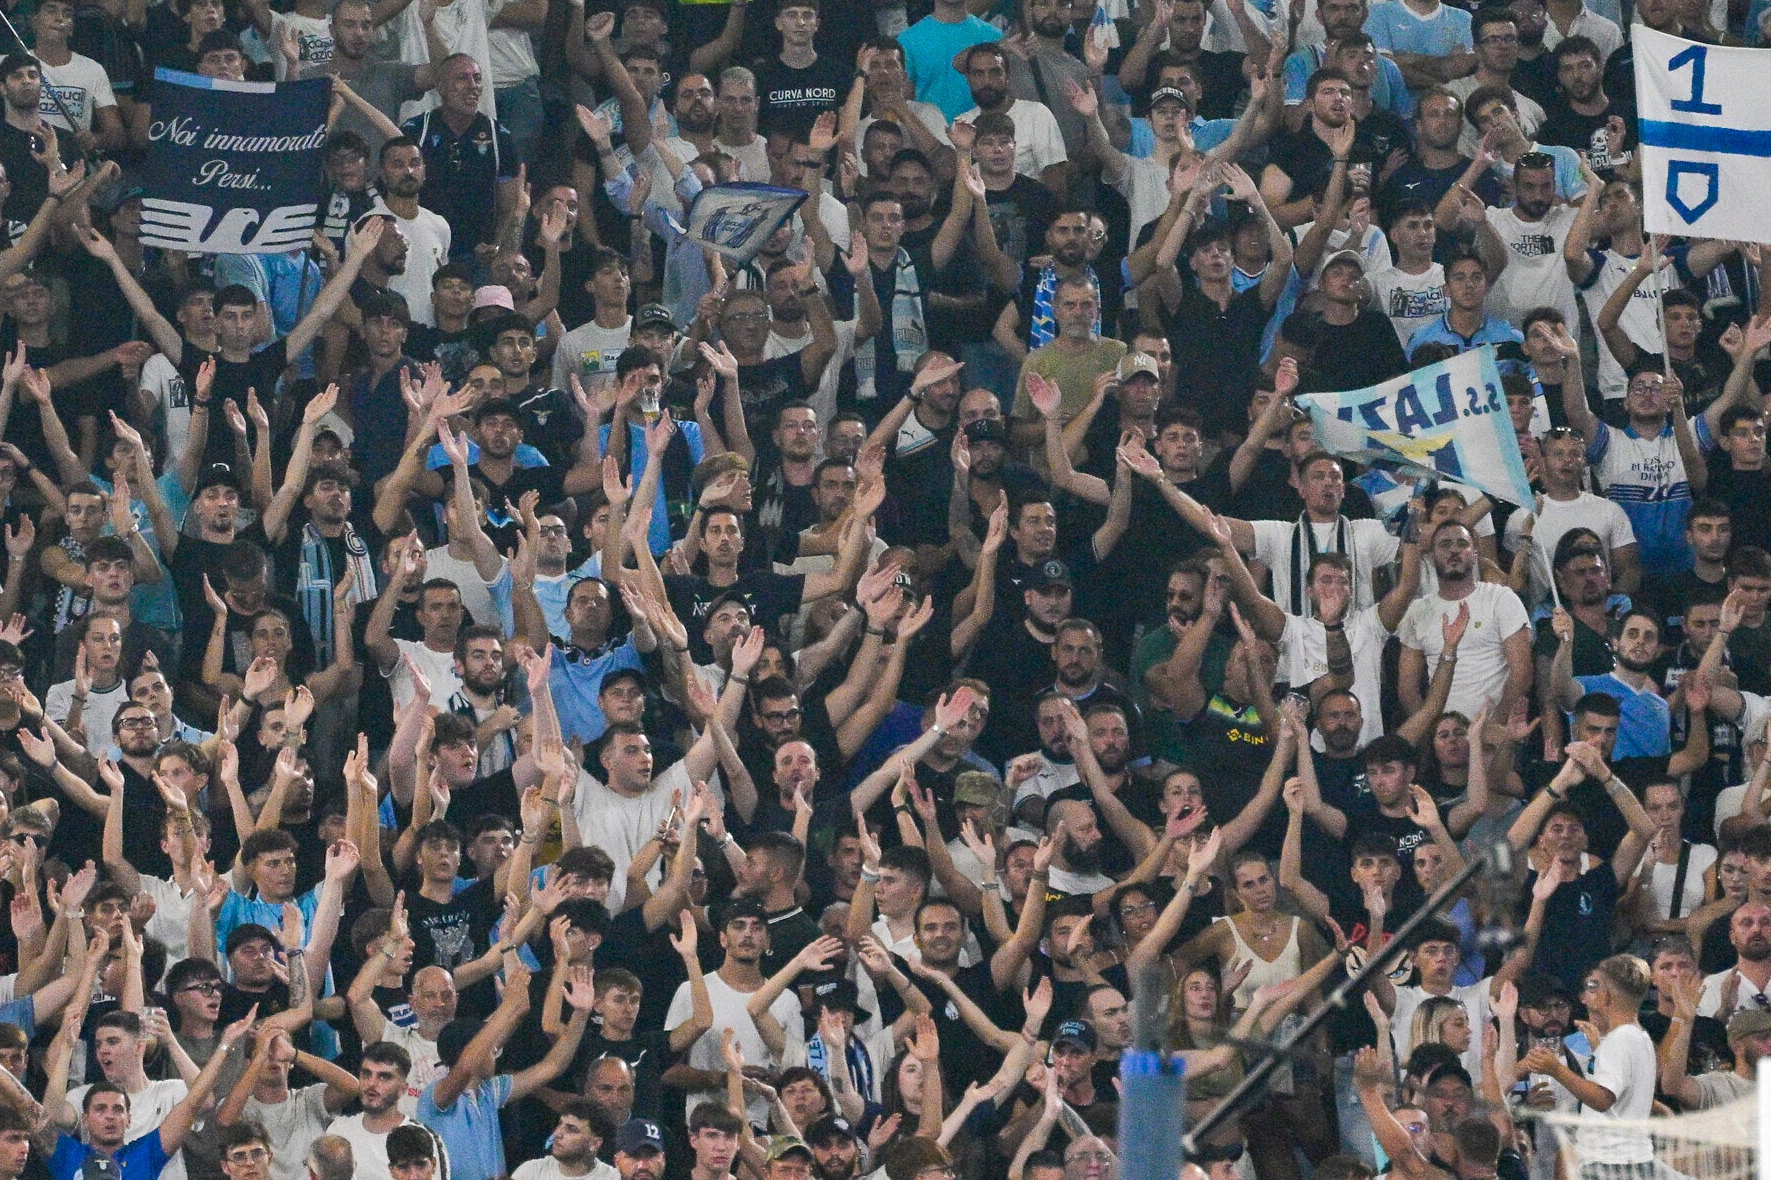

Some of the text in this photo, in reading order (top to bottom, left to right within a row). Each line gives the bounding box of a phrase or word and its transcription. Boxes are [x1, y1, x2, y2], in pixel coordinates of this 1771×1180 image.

[769, 87, 836, 102] CURVA NORD
[147, 116, 328, 153] Noi innamorati
[191, 158, 273, 191] Persi...
[644, 1123, 660, 1140] 12
